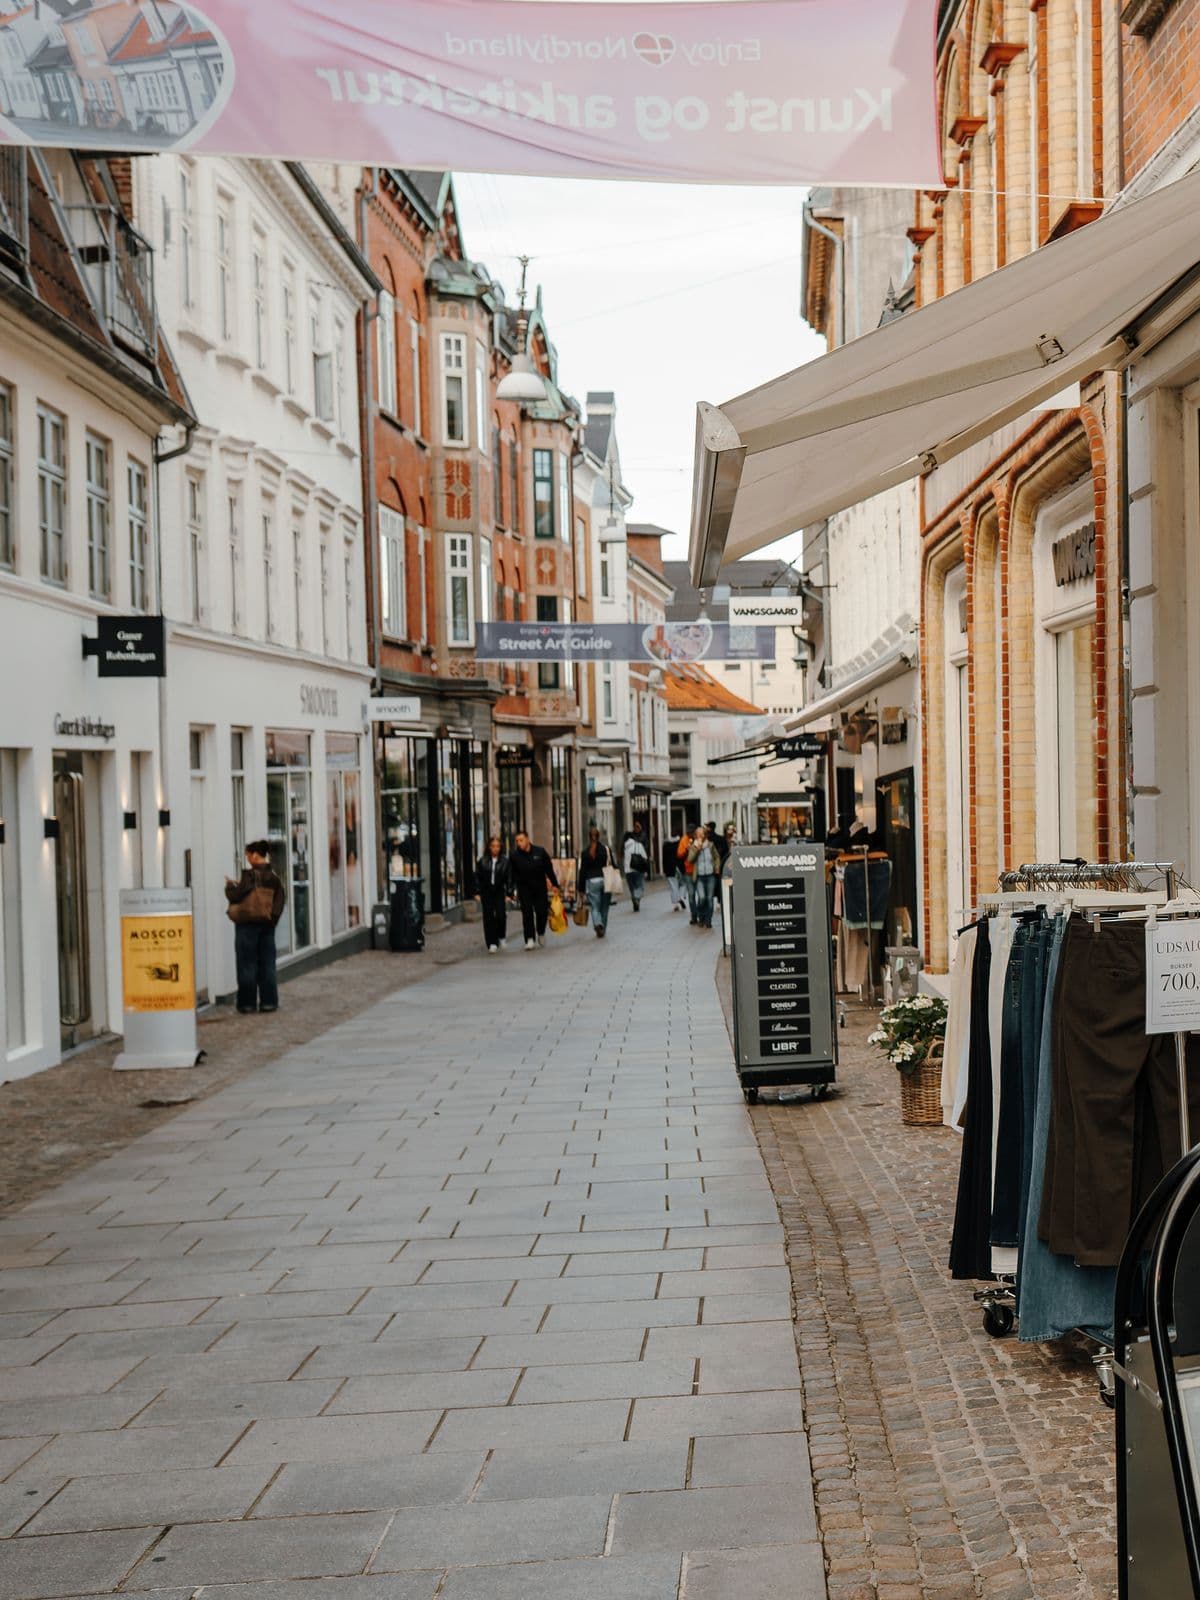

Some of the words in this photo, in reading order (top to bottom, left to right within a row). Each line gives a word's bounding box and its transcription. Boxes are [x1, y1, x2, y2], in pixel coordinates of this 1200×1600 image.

[733, 608, 798, 616] VANGSGAARD
[499, 638, 542, 650] Street
[544, 638, 568, 650] Art
[570, 637, 613, 650] Guide
[376, 704, 411, 713] smooth
[739, 854, 817, 868] VANGSGAARD
[130, 928, 183, 940] MOSCOT
[769, 983, 797, 991] CLOSED
